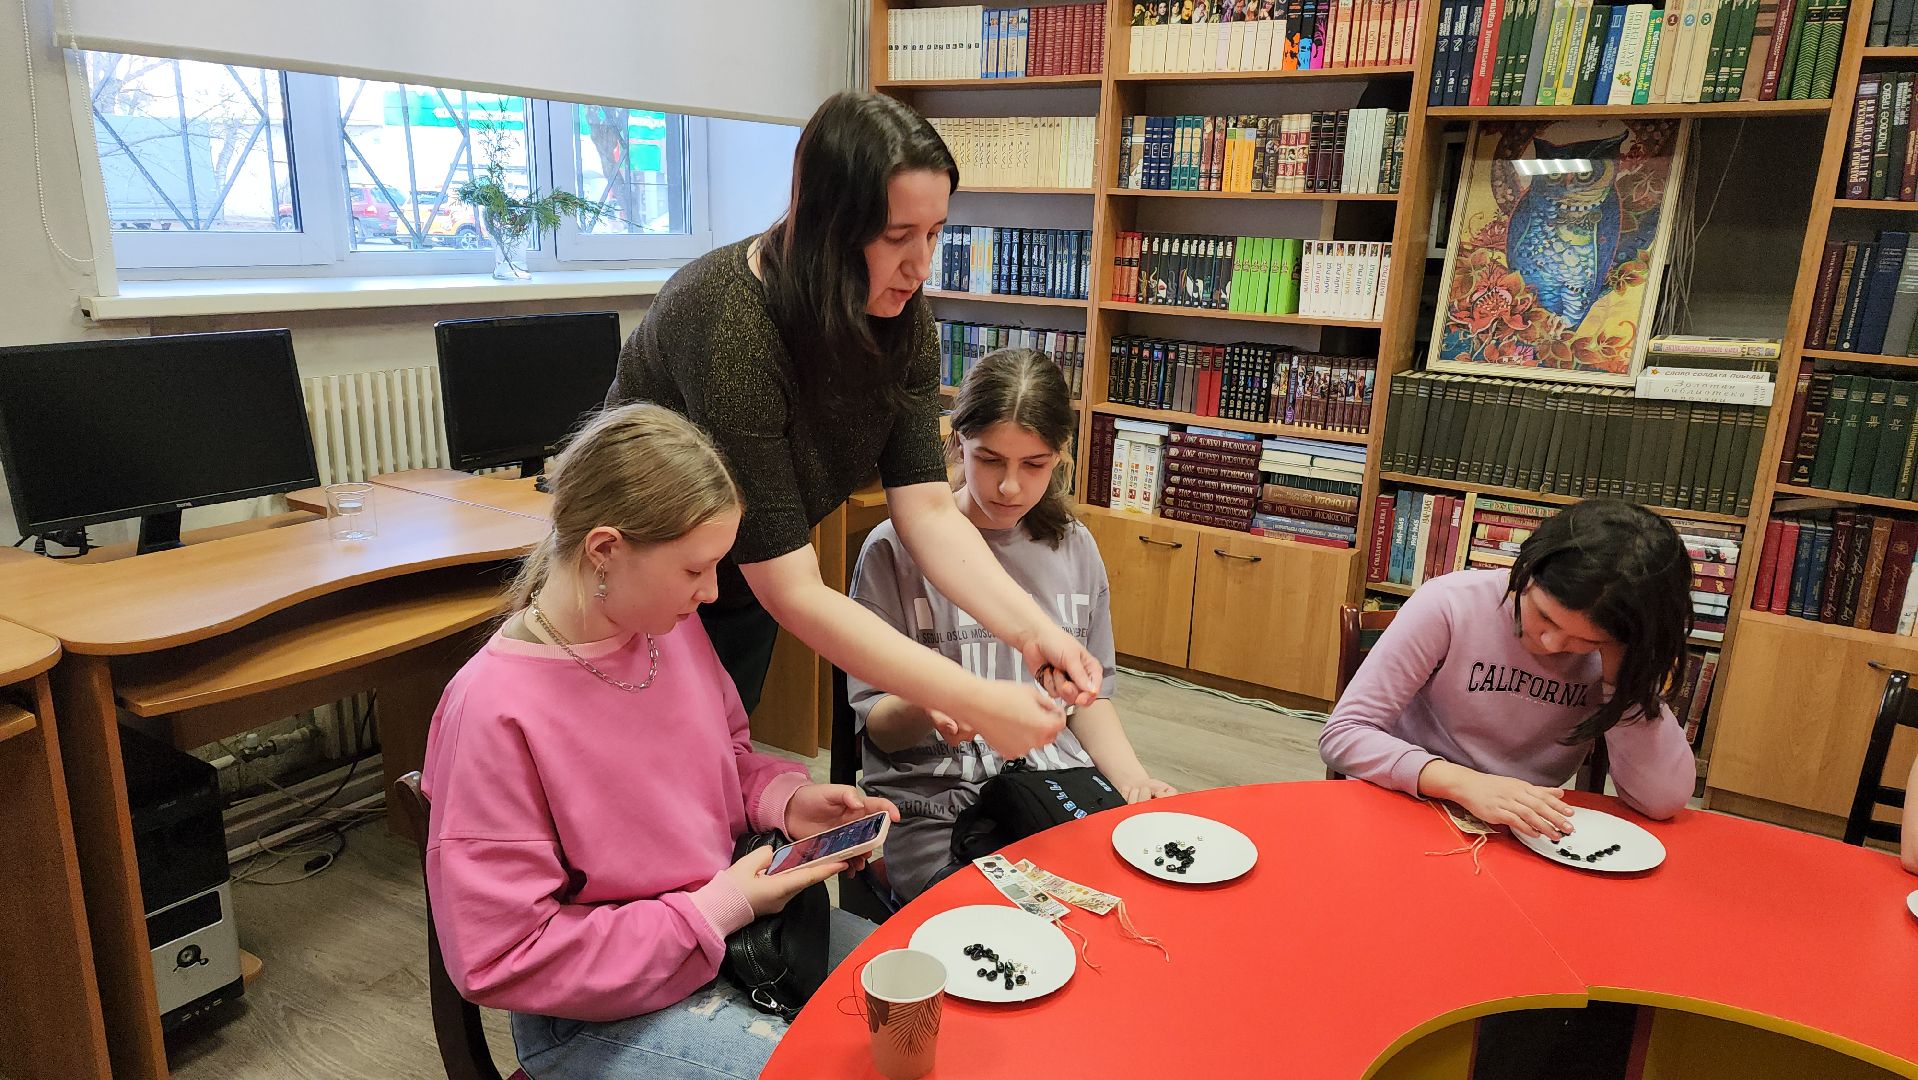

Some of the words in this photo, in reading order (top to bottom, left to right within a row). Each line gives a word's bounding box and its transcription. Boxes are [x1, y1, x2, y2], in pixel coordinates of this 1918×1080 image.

[1624, 11, 1643, 66] РАСТЕНИЯ
[1646, 30, 1659, 76] ветеринара
[1881, 82, 1892, 110] ПРАВО
[1855, 100, 1867, 146] ЮРИДИЧЕСКАЯ
[1877, 113, 1888, 152] ТРУДОВОЕ
[1859, 100, 1876, 183] ЭНЦИКЛОПЕДИЯ
[1850, 148, 1861, 183] БОЛЬШАЯ
[1674, 379, 1735, 390] Золотая
[1730, 372, 1763, 380] ПОБЕДЫ
[1663, 386, 1744, 398] библиотека
[1175, 510, 1189, 519] 2010
[1313, 495, 1345, 508] ГОРОДА
[922, 631, 944, 643] SEOUL
[946, 630, 967, 640] OSLO
[970, 627, 996, 639] MOSC
